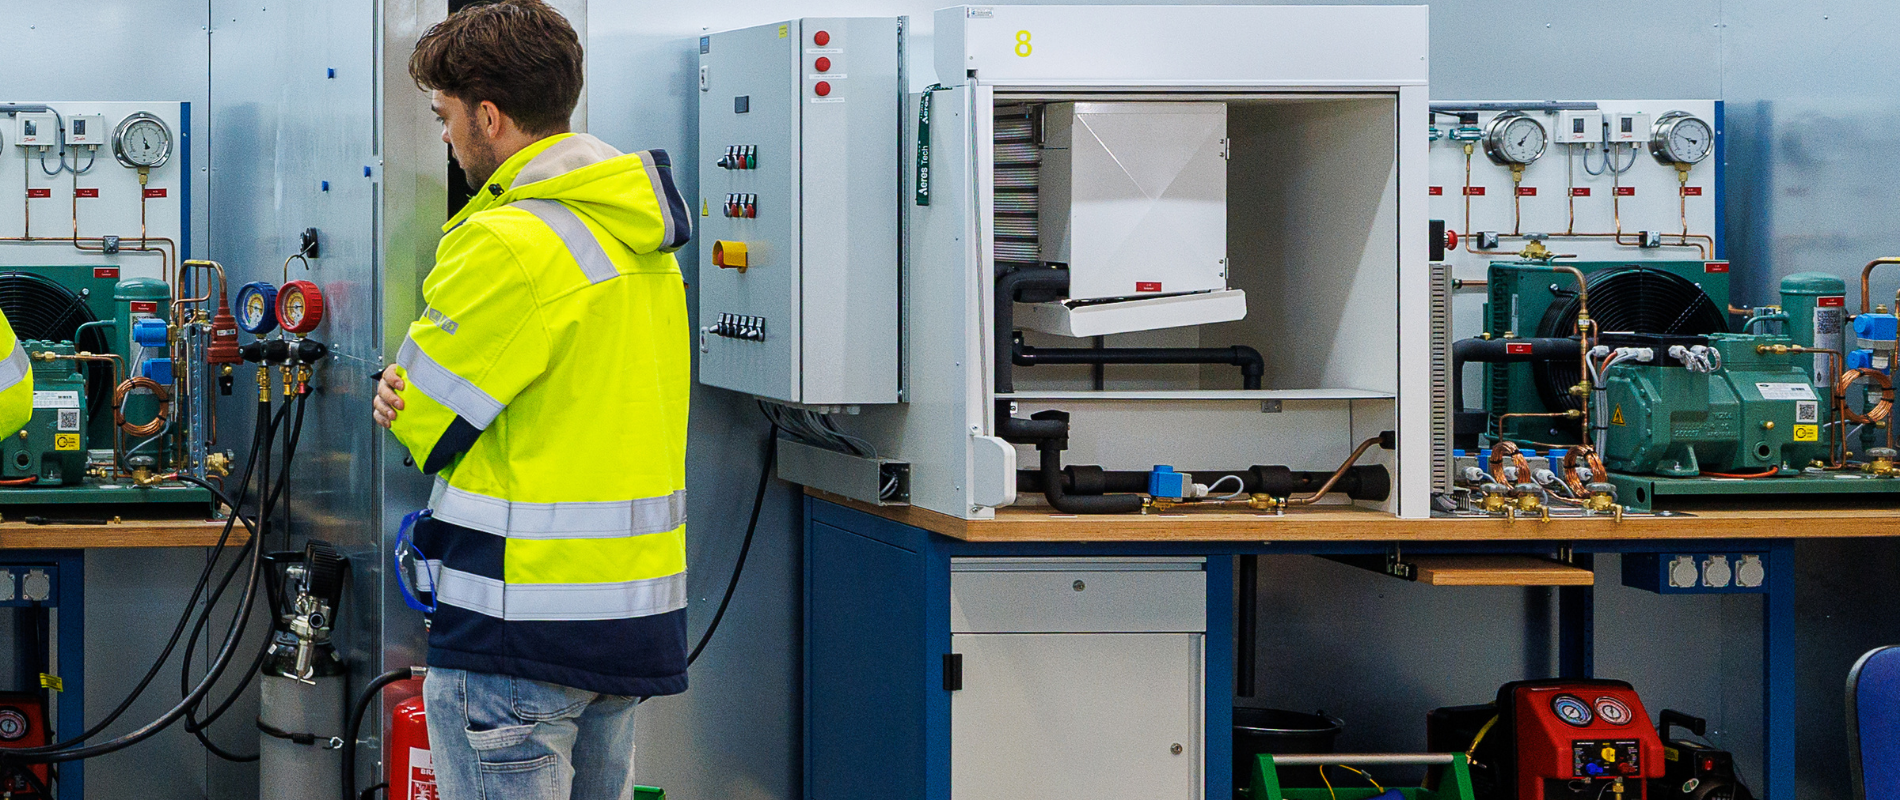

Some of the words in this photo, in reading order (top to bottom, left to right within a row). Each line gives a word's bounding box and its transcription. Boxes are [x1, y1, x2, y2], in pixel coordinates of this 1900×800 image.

[1014, 30, 1032, 58] 8
[921, 145, 929, 165] Tech
[918, 167, 928, 196] Aeres
